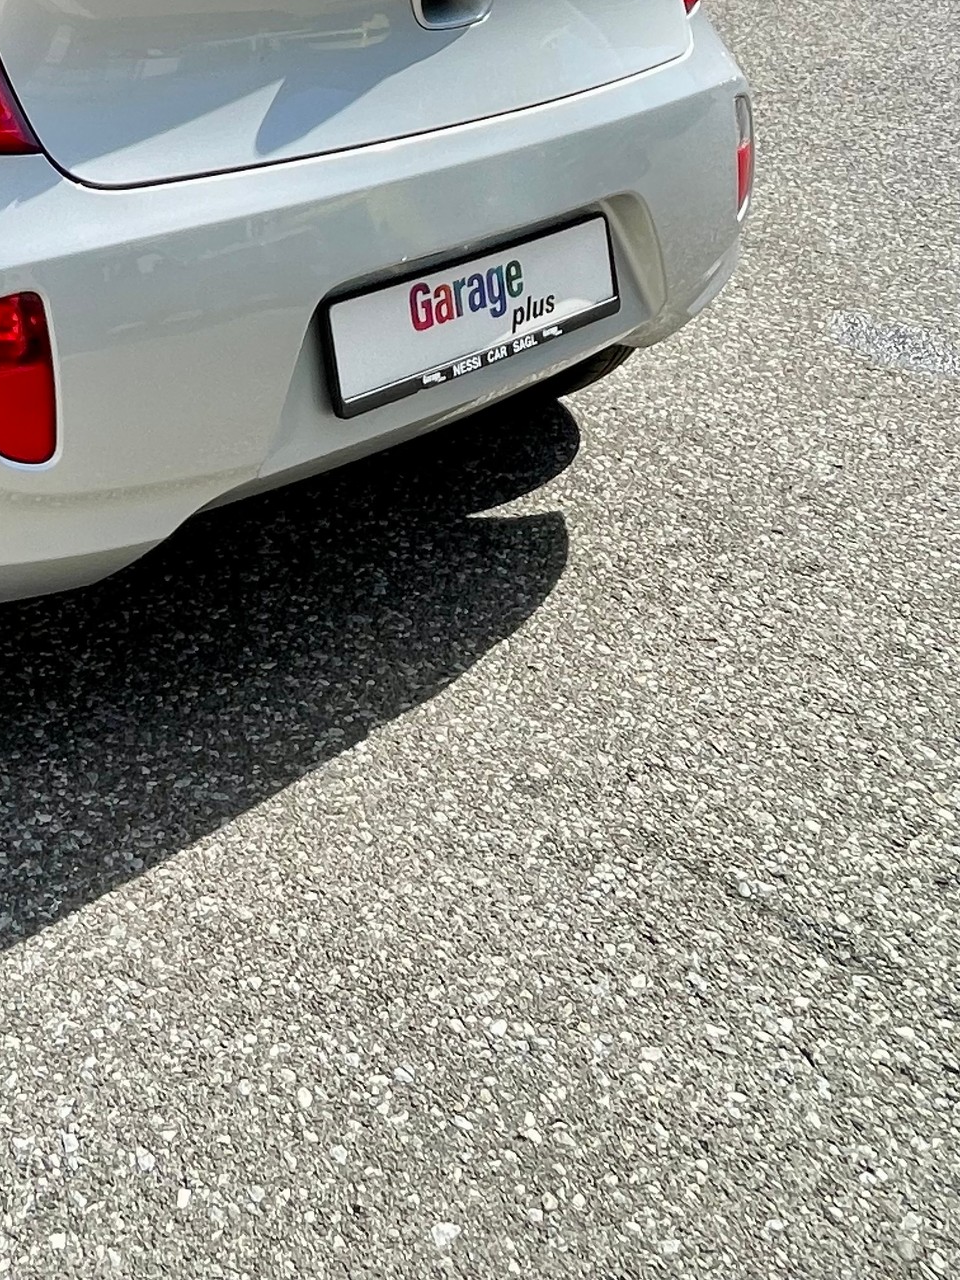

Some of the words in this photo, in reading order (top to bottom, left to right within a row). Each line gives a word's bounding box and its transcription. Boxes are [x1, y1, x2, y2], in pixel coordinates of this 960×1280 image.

[409, 260, 523, 331] Garage
[512, 294, 555, 333] plus
[452, 356, 482, 377] NESSI
[487, 346, 508, 363] CAR
[512, 335, 538, 353] SAGL
